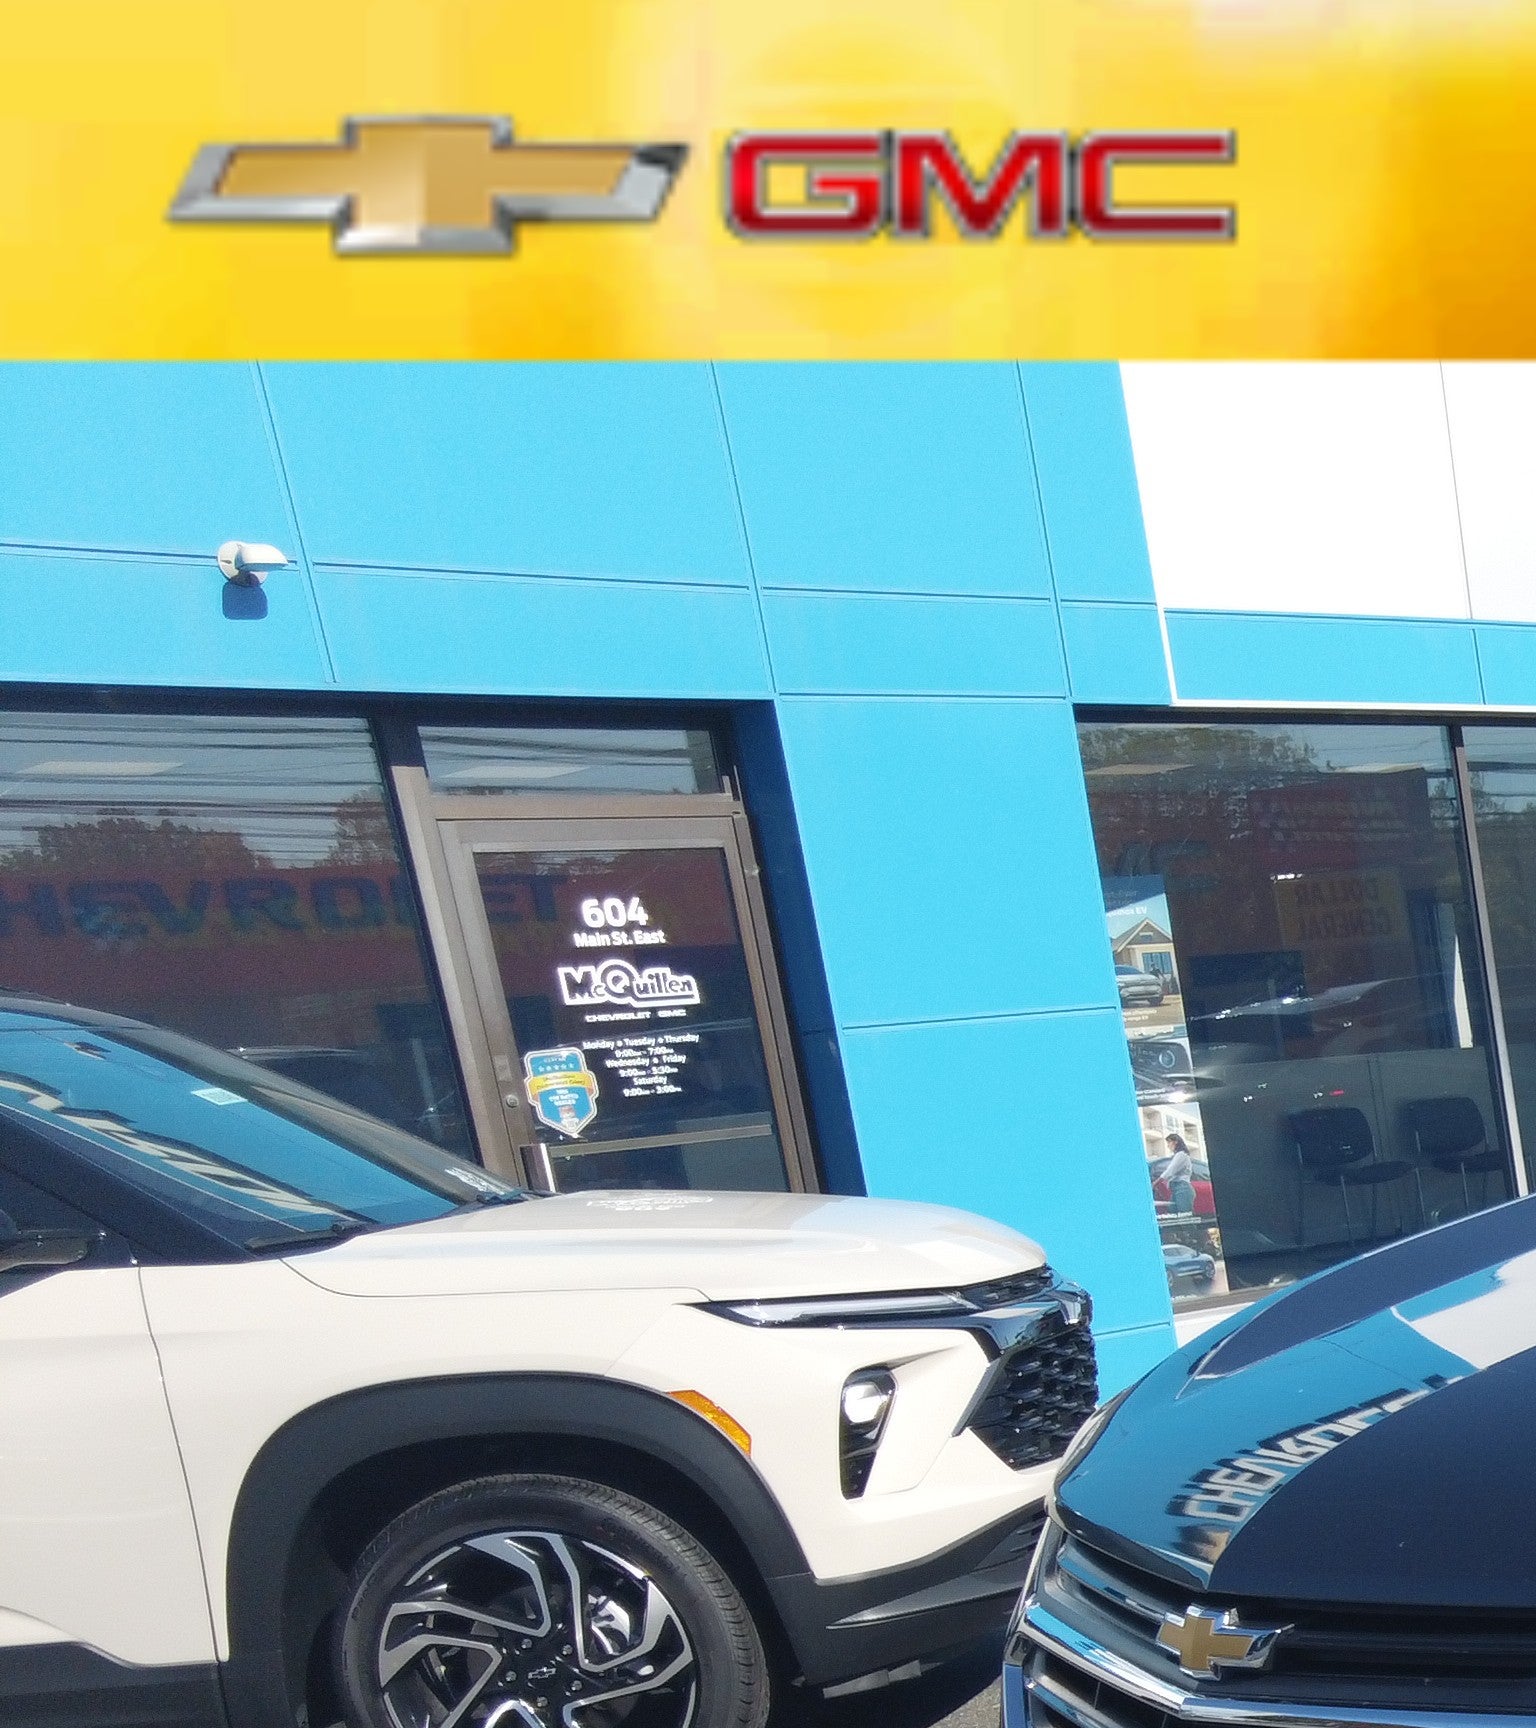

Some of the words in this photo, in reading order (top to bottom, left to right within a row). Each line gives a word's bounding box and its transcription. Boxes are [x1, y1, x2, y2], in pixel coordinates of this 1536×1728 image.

[581, 897, 649, 928] 604
[574, 932, 611, 948] Main
[611, 931, 633, 946] St.
[633, 929, 667, 945] East
[558, 959, 700, 1008] McQuillen
[585, 1011, 651, 1022] CHEVROLET
